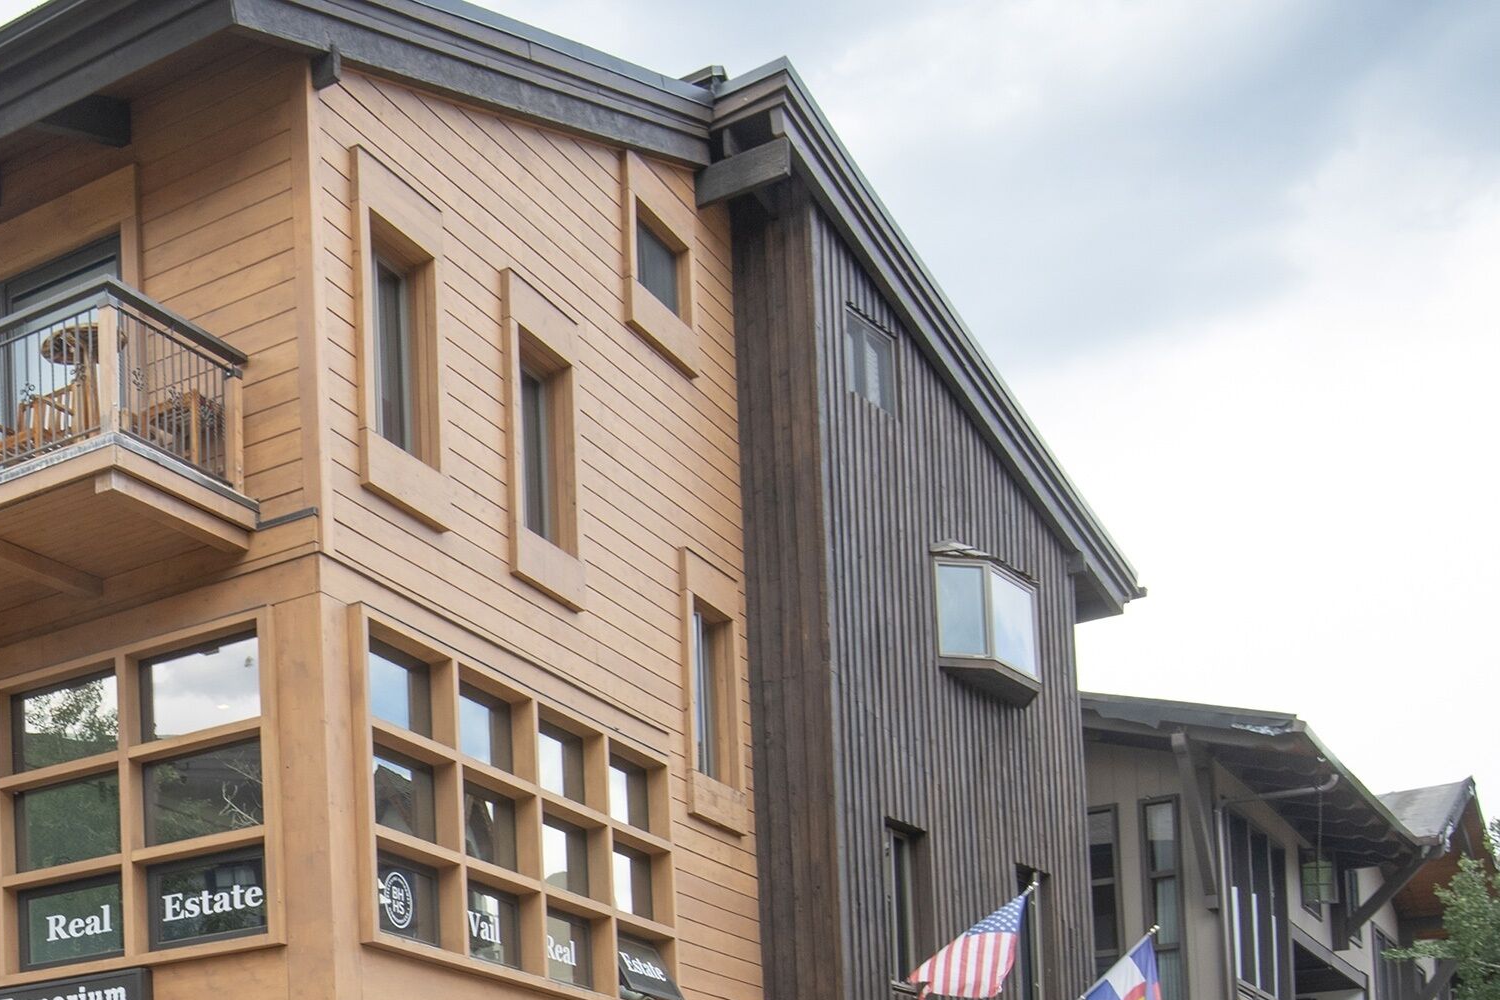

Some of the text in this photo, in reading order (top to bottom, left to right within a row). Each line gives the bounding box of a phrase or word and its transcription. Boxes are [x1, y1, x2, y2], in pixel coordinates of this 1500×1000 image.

[392, 886, 405, 901] BH
[392, 900, 405, 915] HS
[46, 904, 113, 942] Real
[162, 884, 264, 922] Estate
[467, 910, 667, 982] Vail Real Estate
